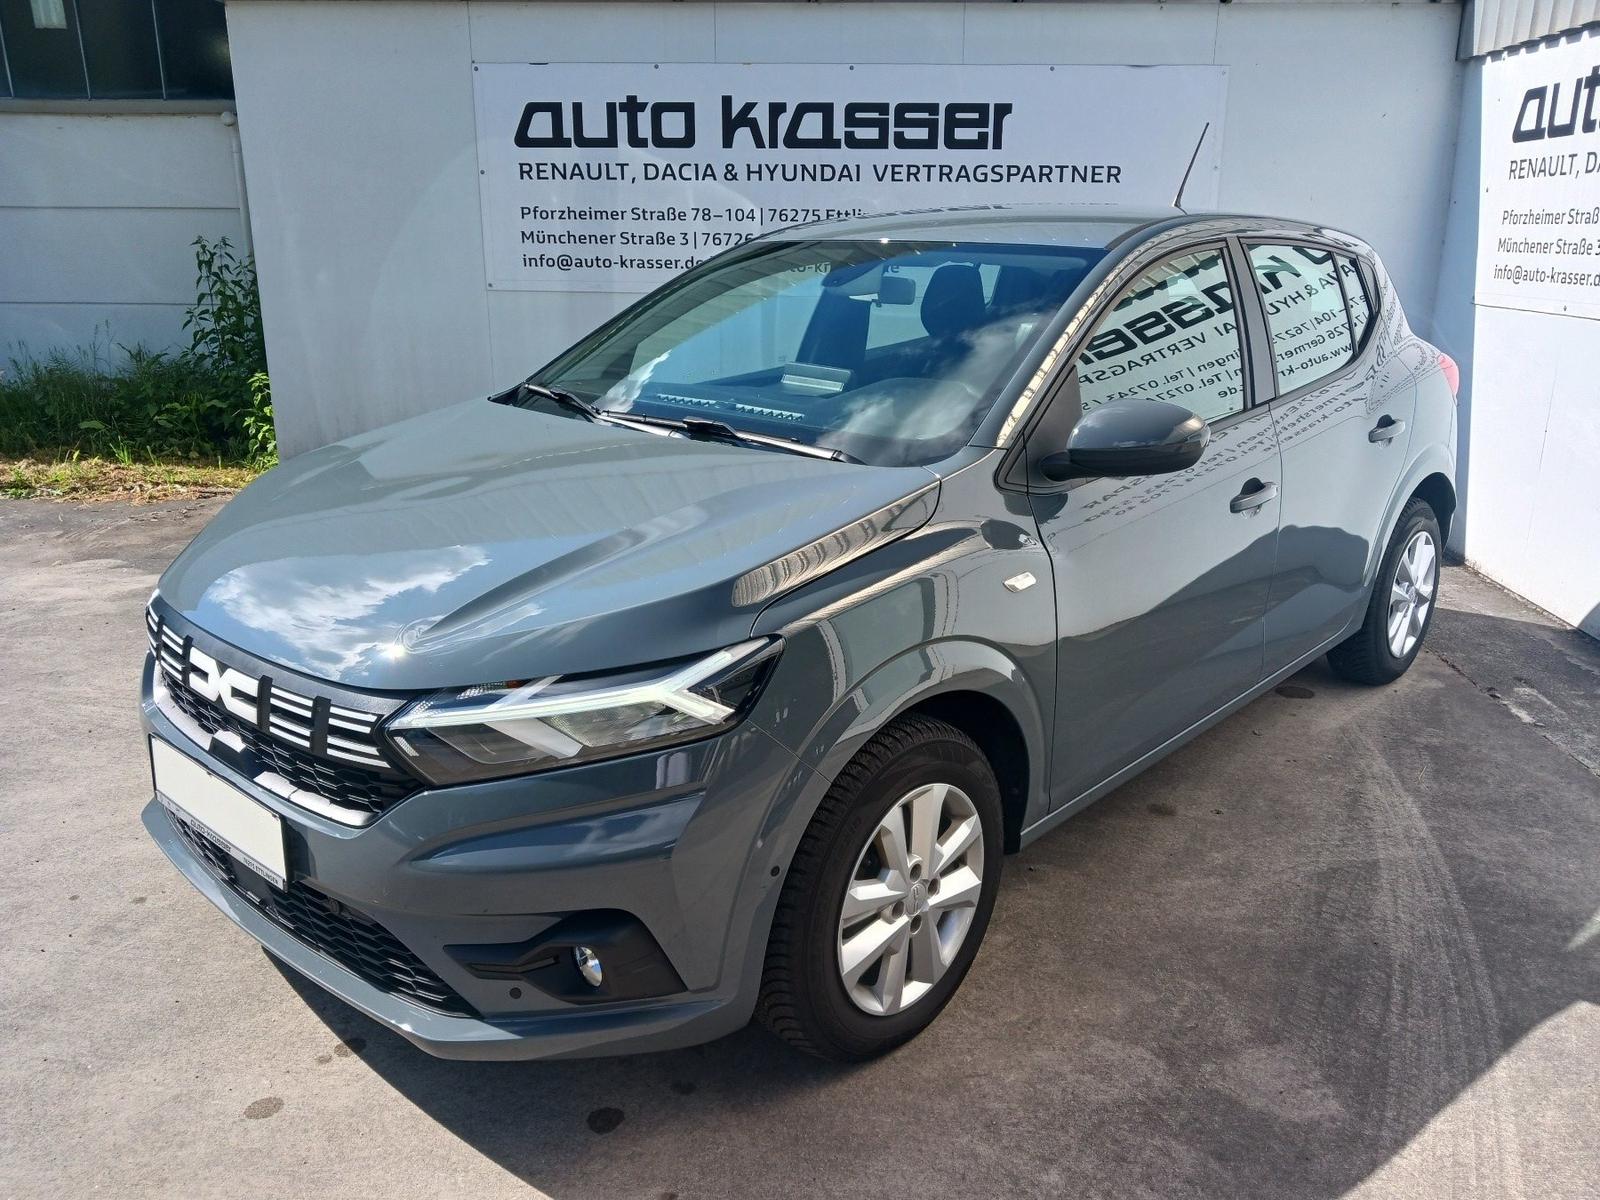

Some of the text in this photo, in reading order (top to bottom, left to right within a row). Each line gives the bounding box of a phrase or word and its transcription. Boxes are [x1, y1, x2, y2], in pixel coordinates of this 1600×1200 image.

[1512, 66, 1600, 143] aut
[514, 95, 1013, 150] auto krasser
[519, 162, 1123, 184] RENAULT, DACIA & HYUNDAI VERTRAGSPARTNER
[1508, 153, 1579, 180] RENAULT,
[520, 206, 627, 221] Pforzheimer
[631, 207, 687, 222] Straße
[768, 208, 821, 223] 76275
[1501, 206, 1600, 226] Pforzheimer Straß
[520, 230, 617, 245] Münchener
[620, 231, 676, 246] Straße
[679, 232, 689, 246] 3
[1497, 238, 1555, 255] Münchener
[1555, 238, 1593, 255] Straße
